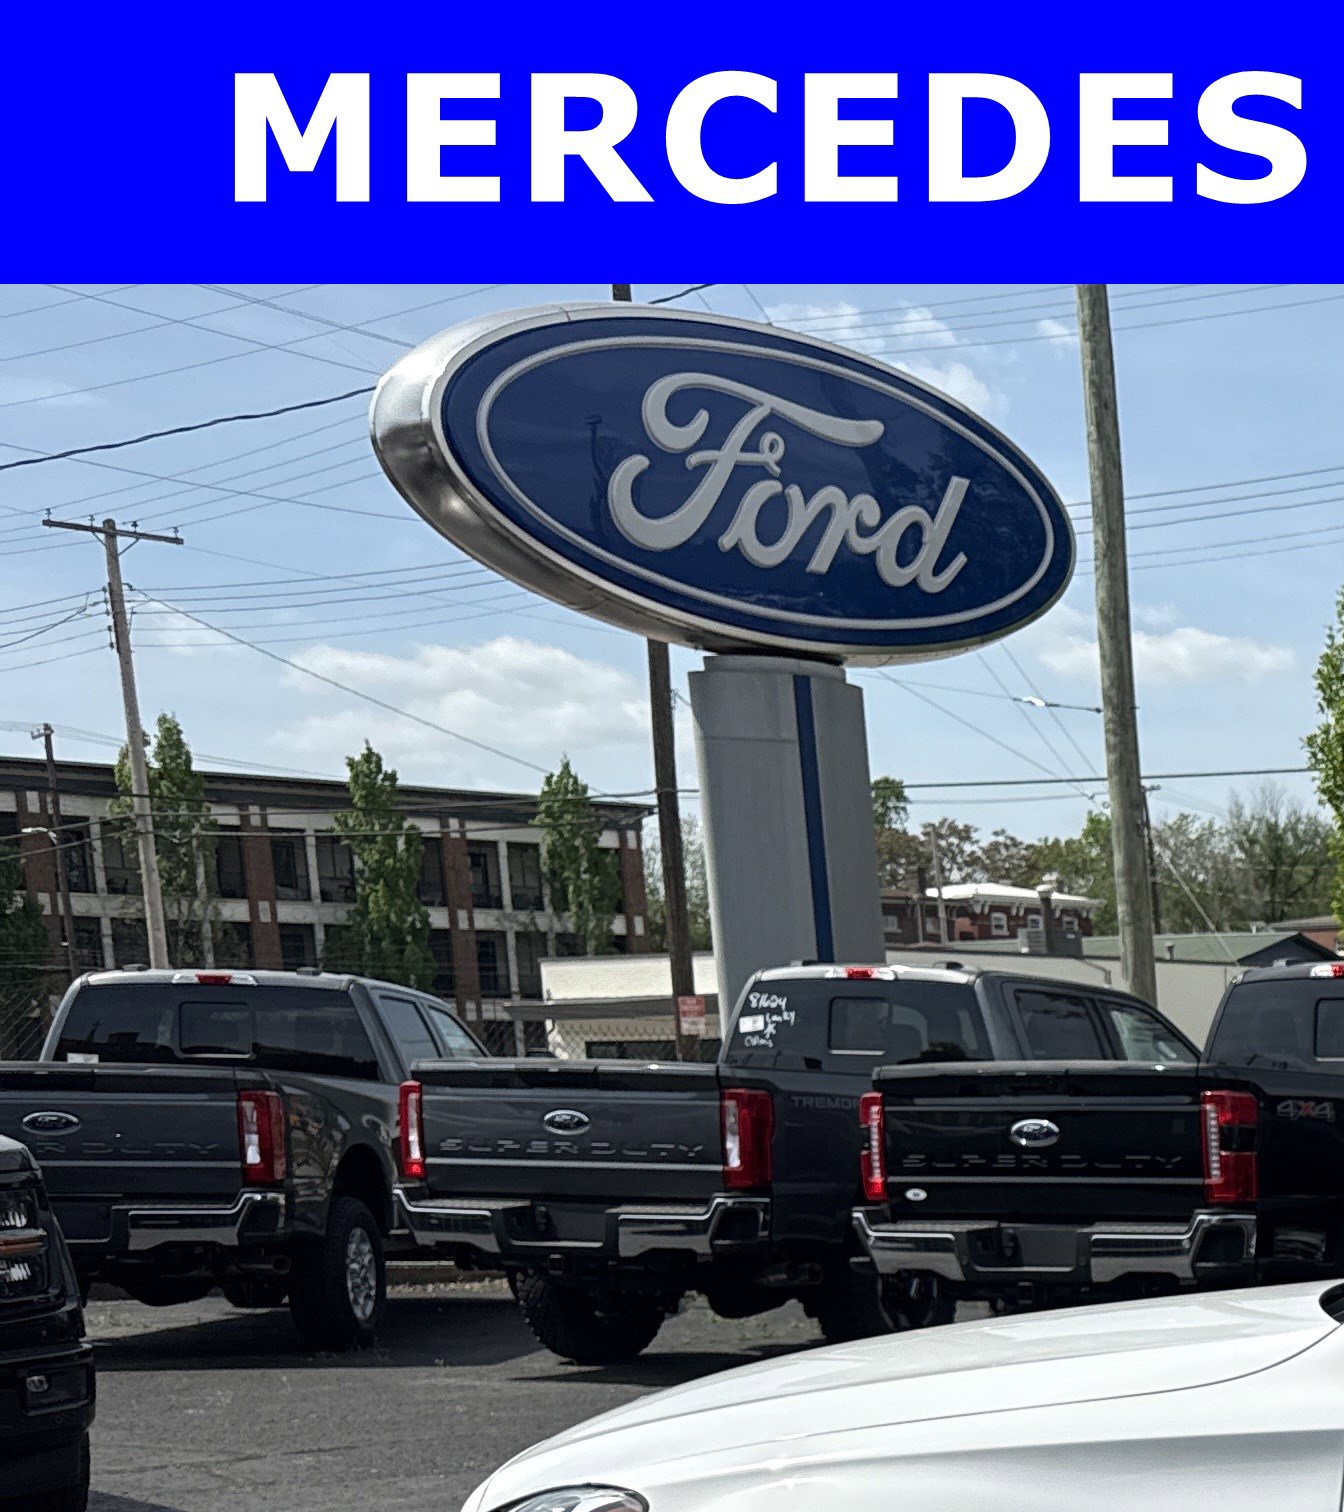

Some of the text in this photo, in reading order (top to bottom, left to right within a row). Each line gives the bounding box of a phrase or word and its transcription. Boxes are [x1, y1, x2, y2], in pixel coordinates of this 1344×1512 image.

[608, 372, 971, 594] Ford
[439, 1137, 704, 1157] SUPER DUTY
[901, 1153, 1184, 1170] SUPER DUTY
